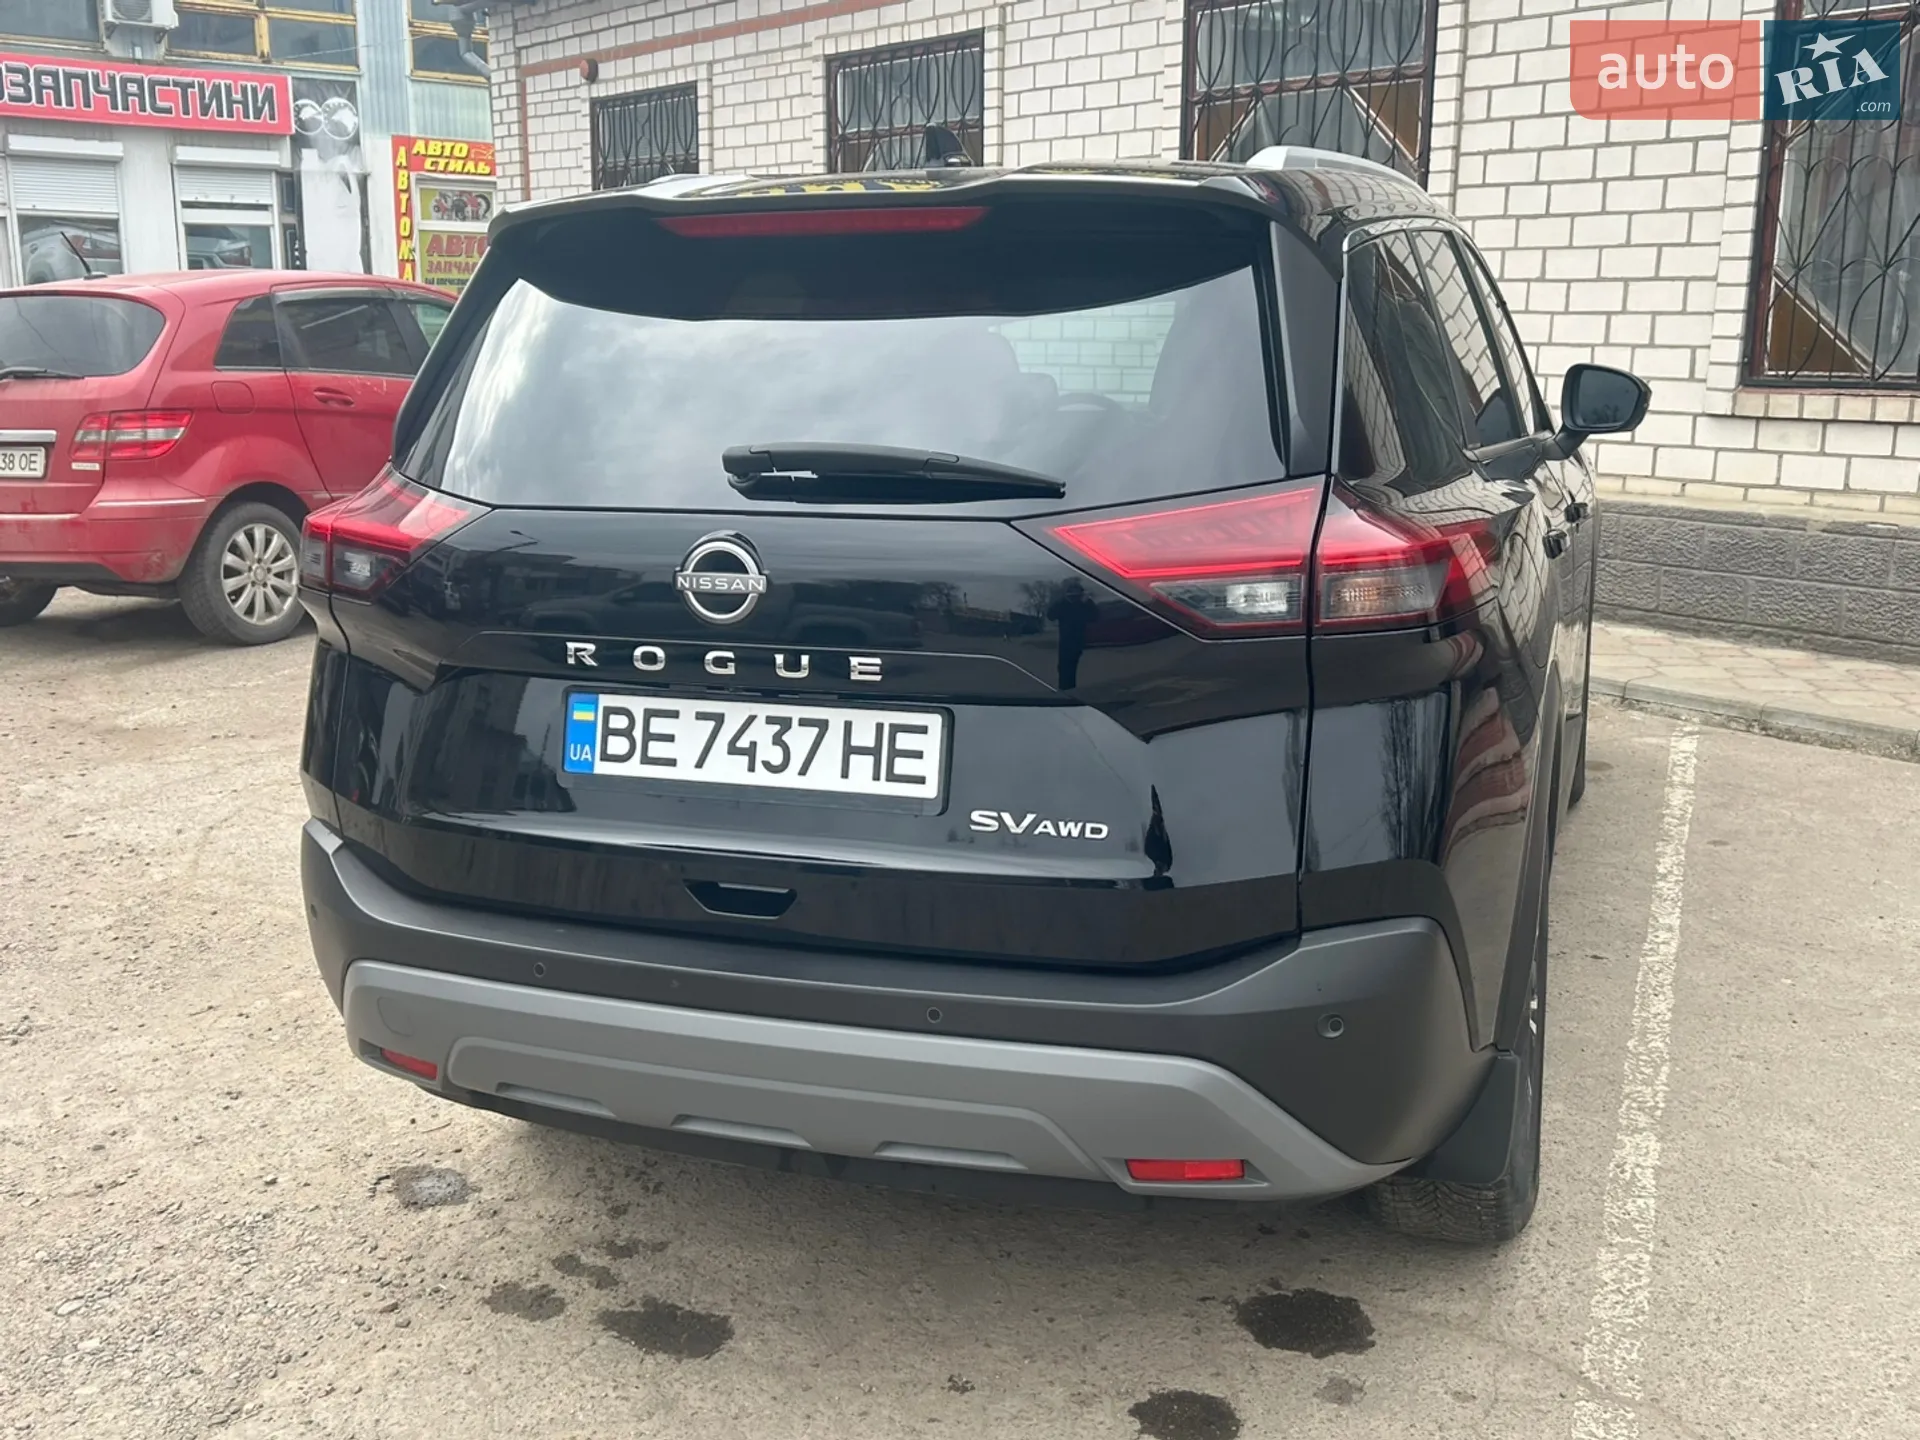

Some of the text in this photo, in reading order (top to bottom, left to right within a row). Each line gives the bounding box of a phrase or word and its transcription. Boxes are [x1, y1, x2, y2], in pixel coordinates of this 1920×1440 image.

[0, 61, 279, 124] ЗАПЧАСТИНИ
[412, 139, 469, 158] АВТО
[424, 157, 491, 175] СТИЛЬ
[677, 576, 764, 591] NISSAN
[566, 640, 883, 682] ROGUE
[569, 743, 592, 761] UA
